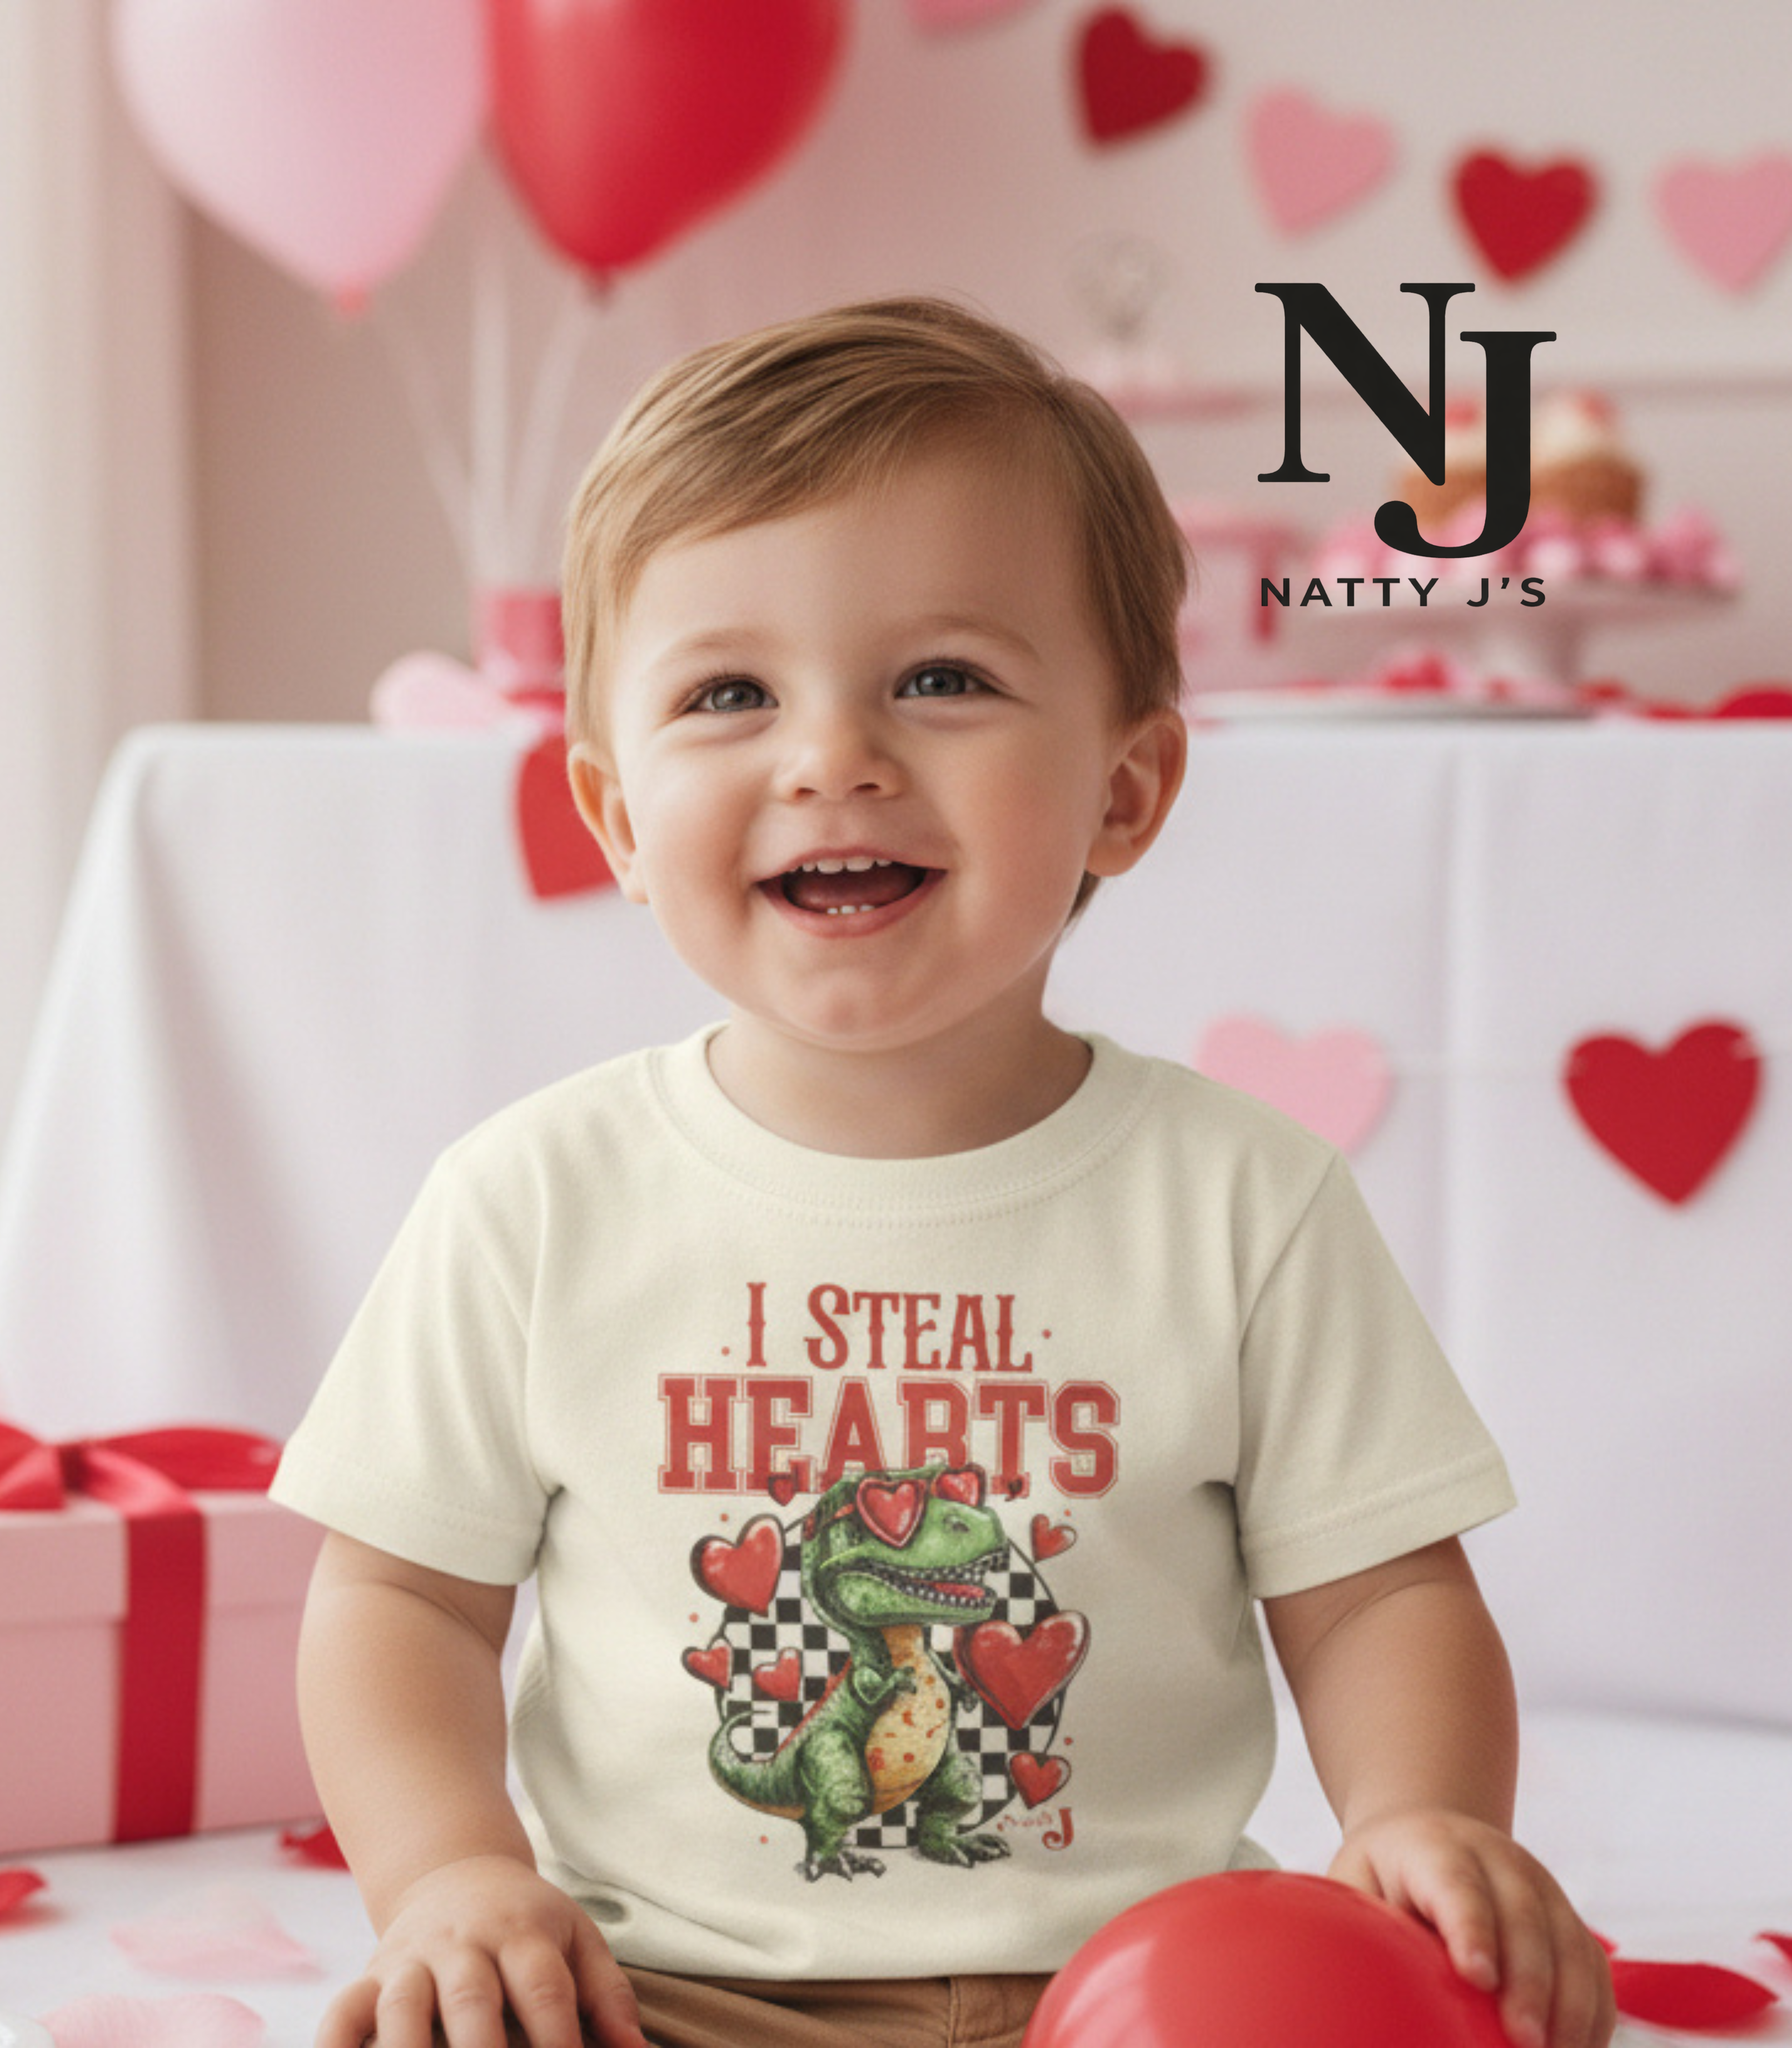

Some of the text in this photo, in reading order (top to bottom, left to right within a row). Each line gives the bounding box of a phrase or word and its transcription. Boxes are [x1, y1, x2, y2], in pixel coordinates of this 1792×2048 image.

[746, 1282, 1033, 1372] I STEAL
[658, 1373, 1121, 1499] HEARTS
